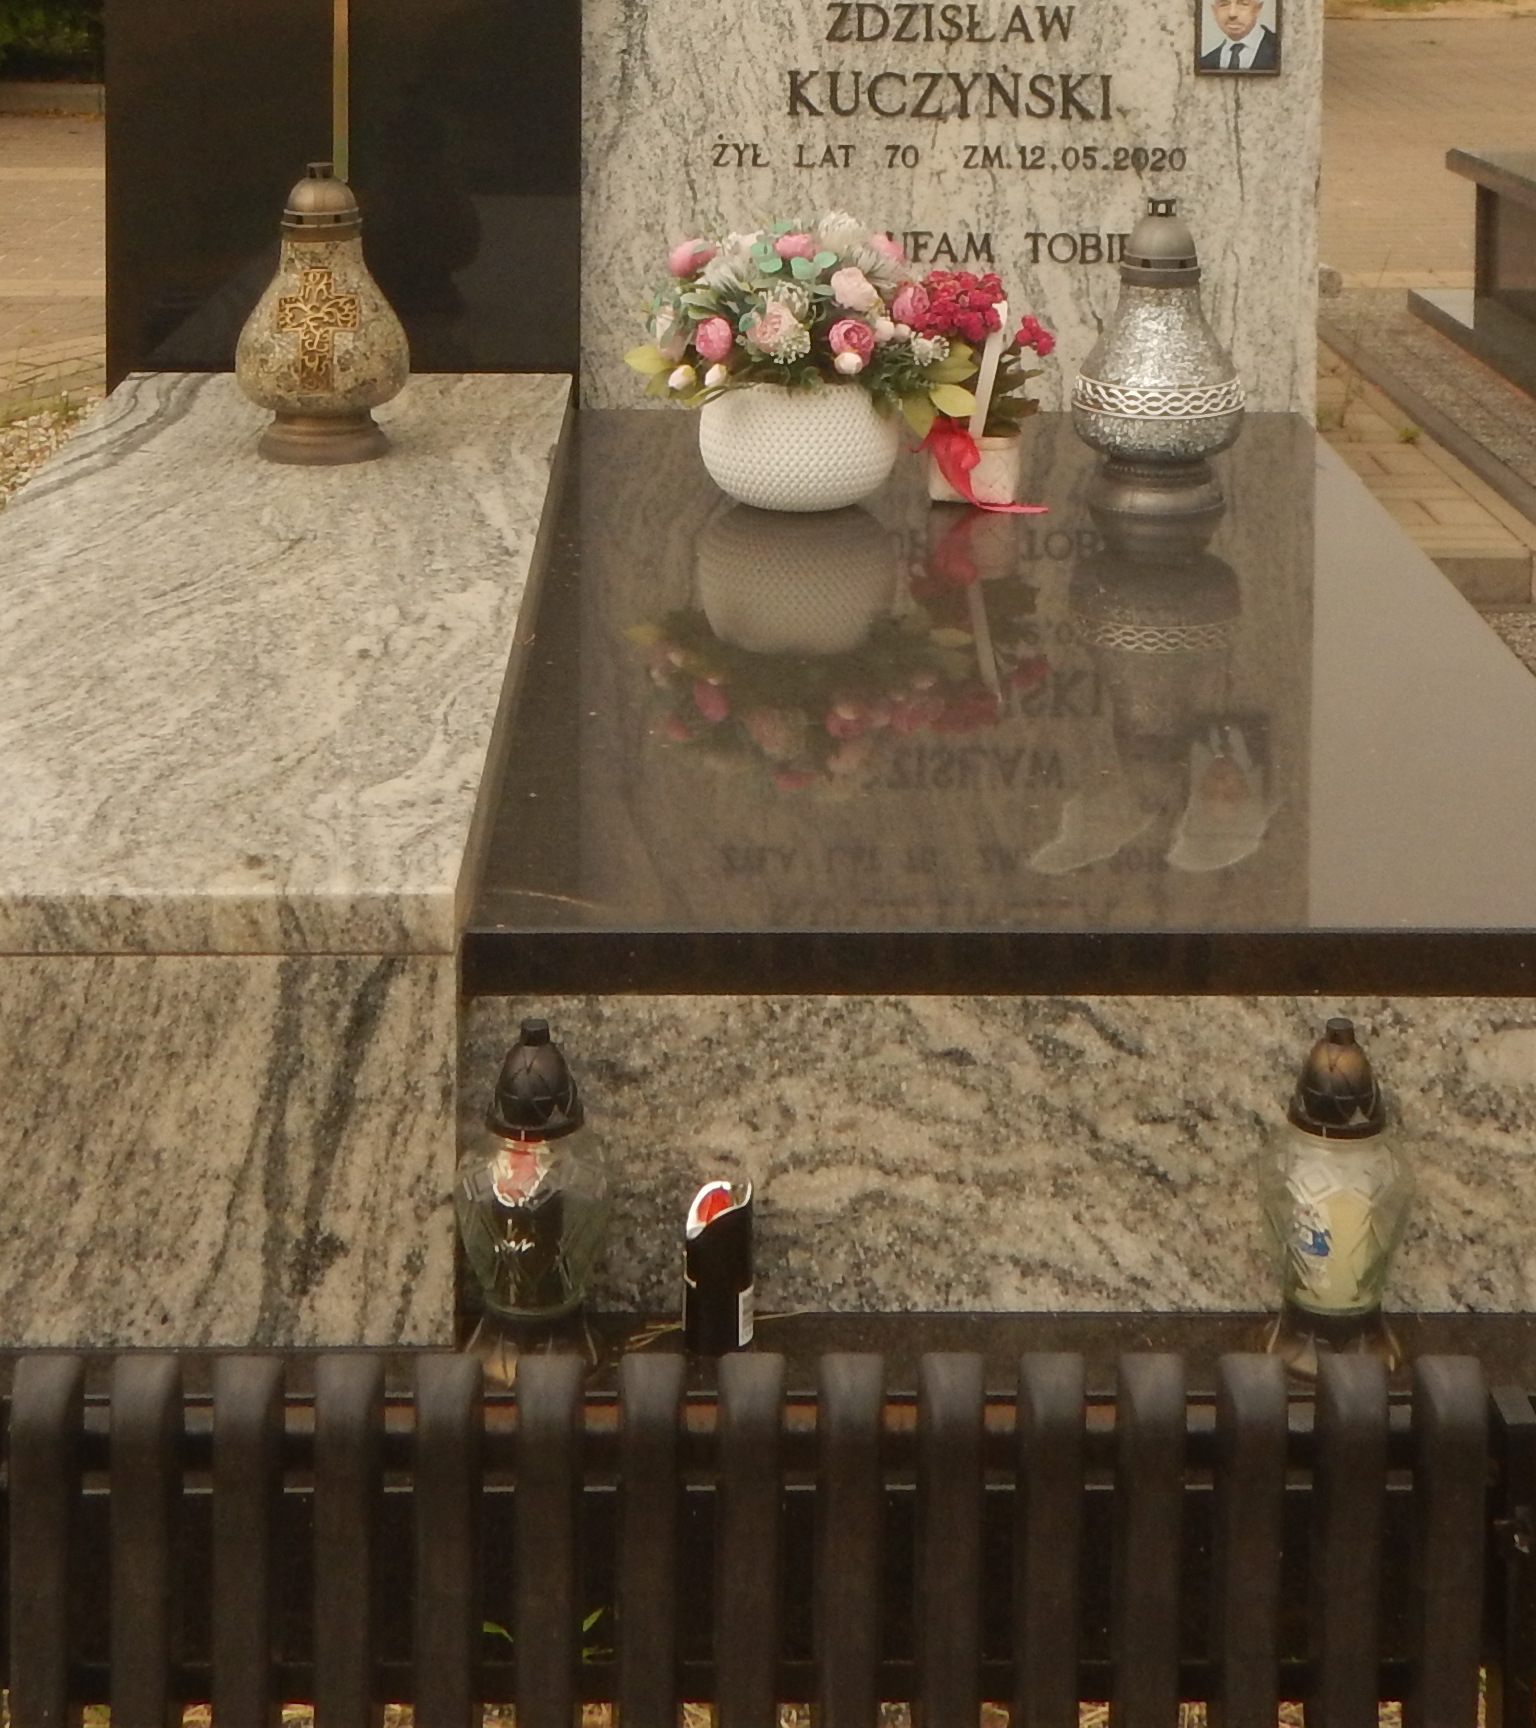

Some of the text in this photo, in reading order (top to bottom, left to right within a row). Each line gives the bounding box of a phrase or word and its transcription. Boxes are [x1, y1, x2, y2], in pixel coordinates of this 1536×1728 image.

[825, 2, 1076, 43] ZDZISŁAW
[786, 63, 1114, 121] KUCZYŃSKI
[711, 134, 771, 169] ŻYŁ
[794, 144, 857, 170] LAT
[885, 144, 919, 170] 70
